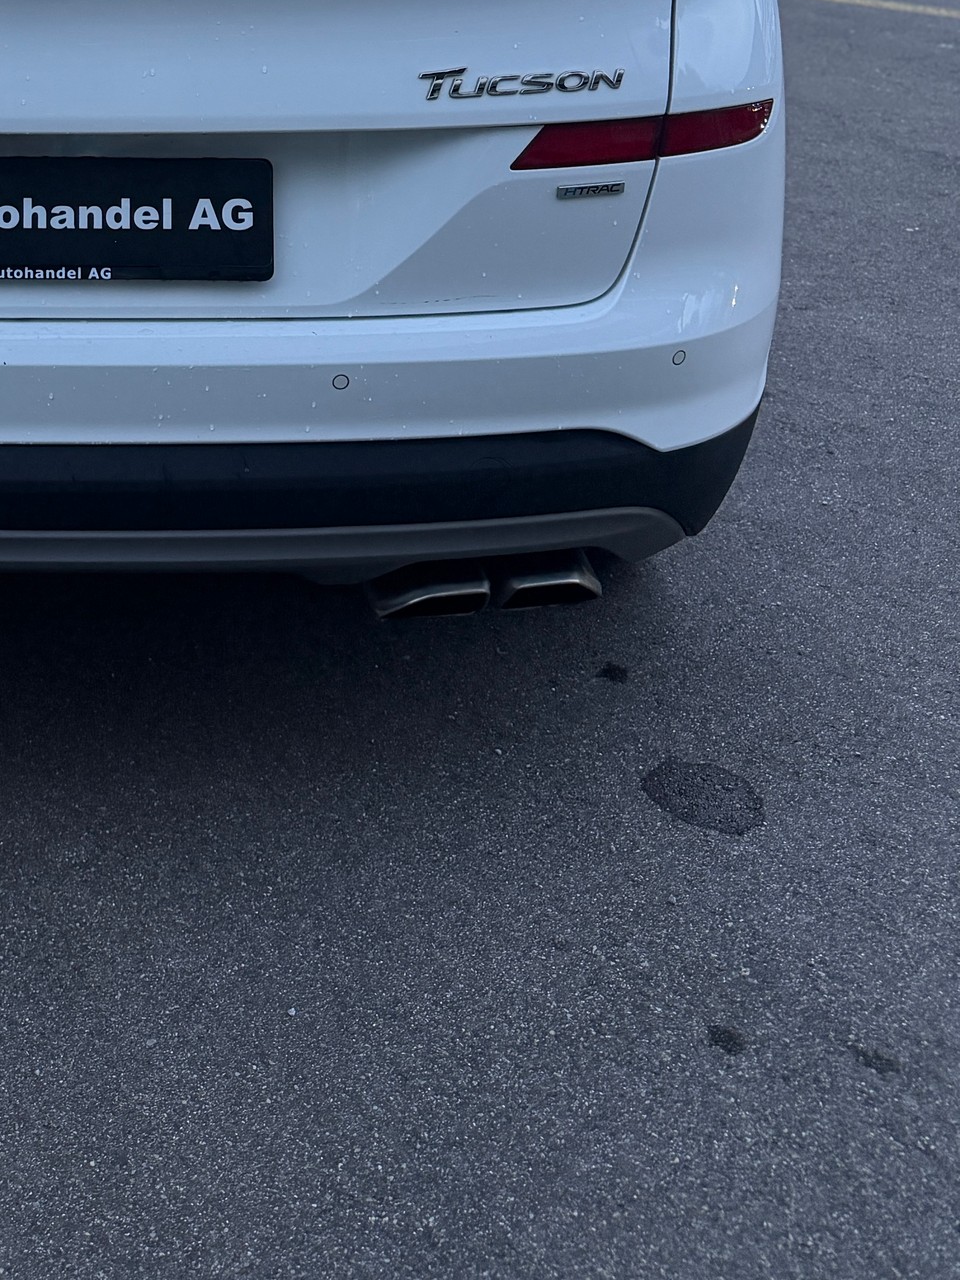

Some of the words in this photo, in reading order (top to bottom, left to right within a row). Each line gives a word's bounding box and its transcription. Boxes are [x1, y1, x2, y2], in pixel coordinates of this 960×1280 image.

[418, 67, 625, 101] TUCSON
[563, 182, 621, 197] HTRAC
[189, 198, 254, 231] AG
[88, 267, 112, 280] AG
